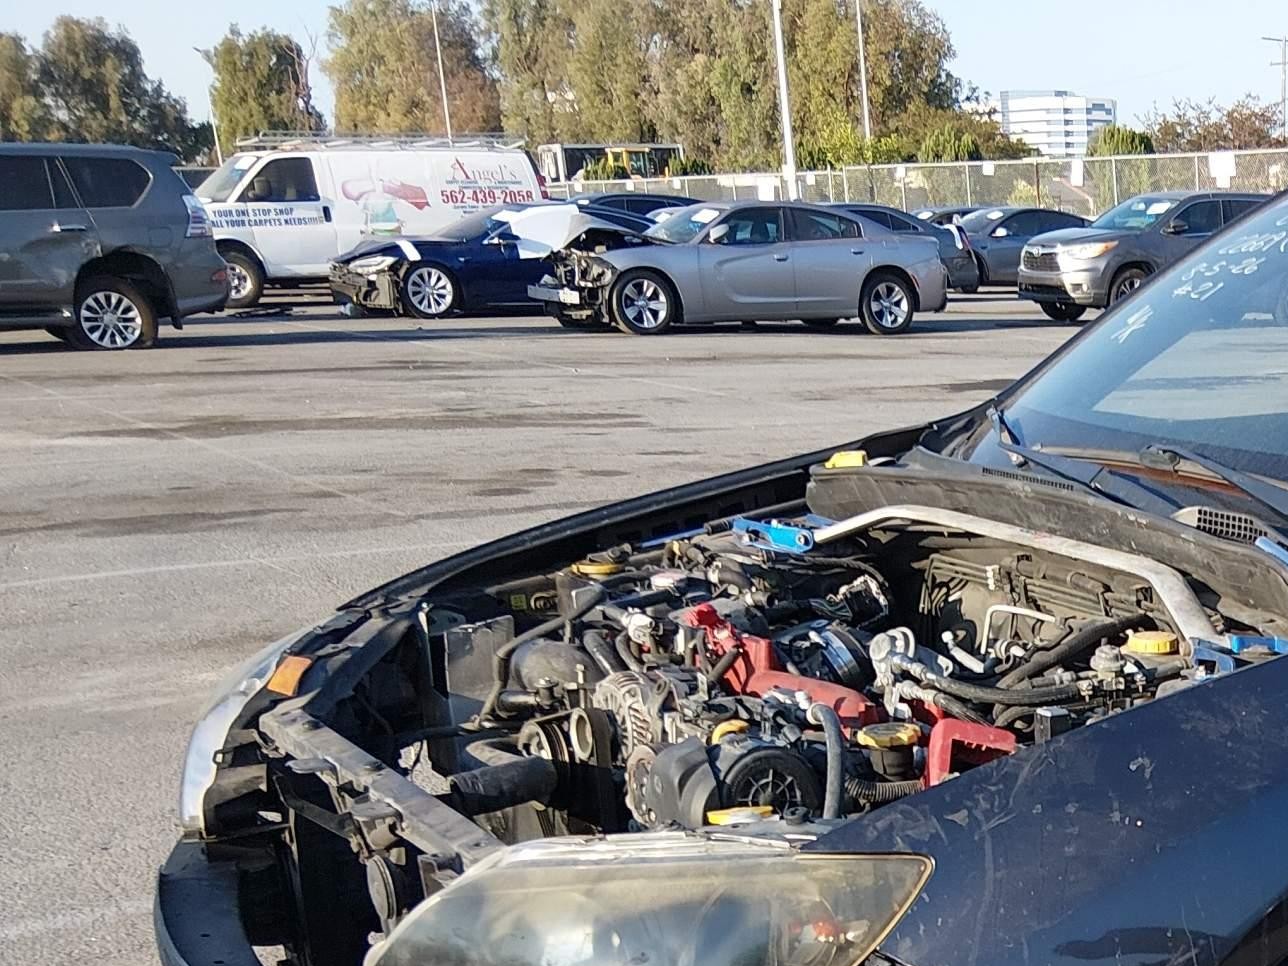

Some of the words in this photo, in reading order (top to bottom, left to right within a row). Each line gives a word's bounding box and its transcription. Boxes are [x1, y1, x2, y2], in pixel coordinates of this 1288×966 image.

[451, 157, 517, 182] Angel's
[440, 189, 534, 204] 562-439-2058
[212, 210, 234, 218] YOUR
[235, 209, 250, 217] ONE
[252, 208, 272, 217] STOP
[274, 207, 294, 217] SHOP
[211, 219, 224, 228] ALL
[225, 219, 246, 227] YOUR
[247, 218, 282, 227] CARPETS
